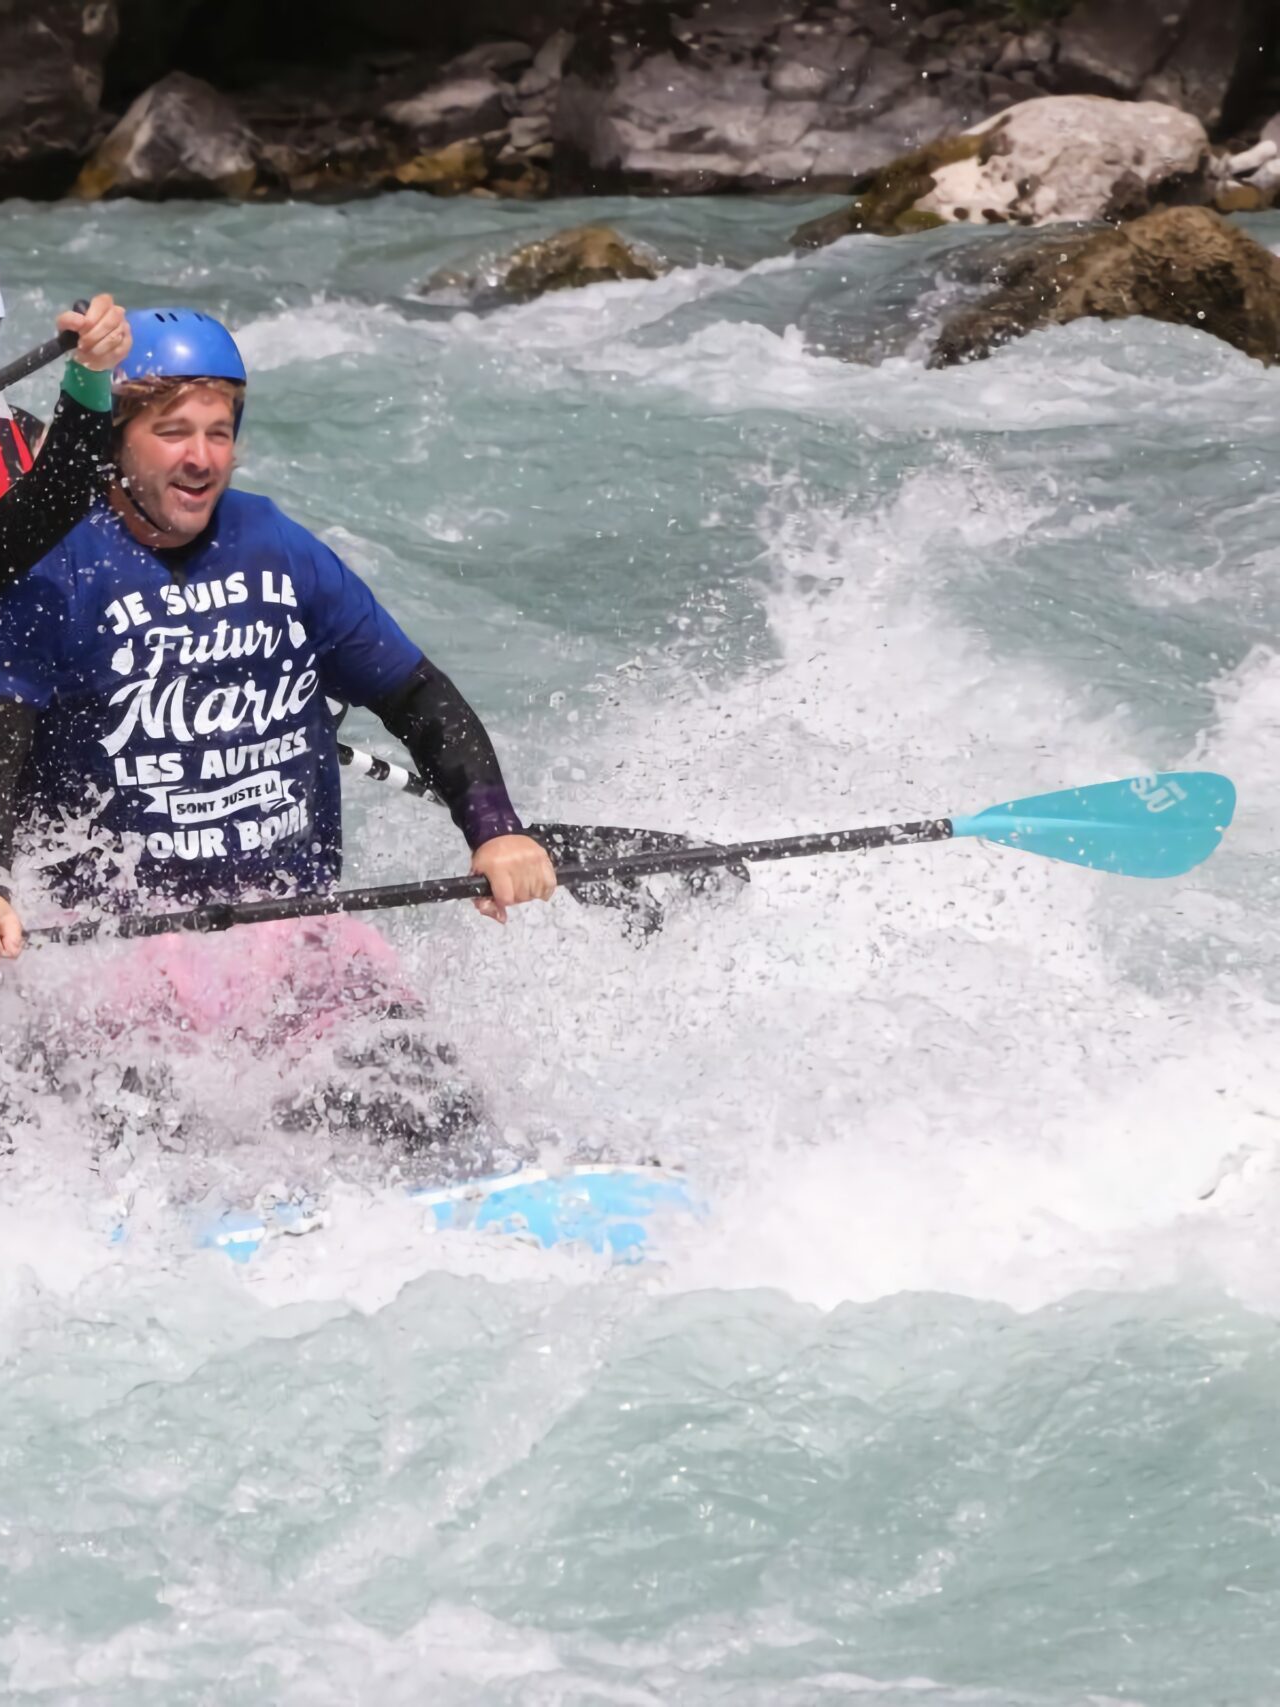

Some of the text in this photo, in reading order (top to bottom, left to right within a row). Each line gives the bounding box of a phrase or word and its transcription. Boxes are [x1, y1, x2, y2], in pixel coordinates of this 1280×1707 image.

[104, 570, 298, 635] JE SUIS LE
[144, 619, 283, 679] Futur
[99, 653, 320, 757] Marié
[114, 726, 310, 787] LES AUTRES
[175, 800, 216, 816] SONT
[221, 784, 263, 809] JUSTE
